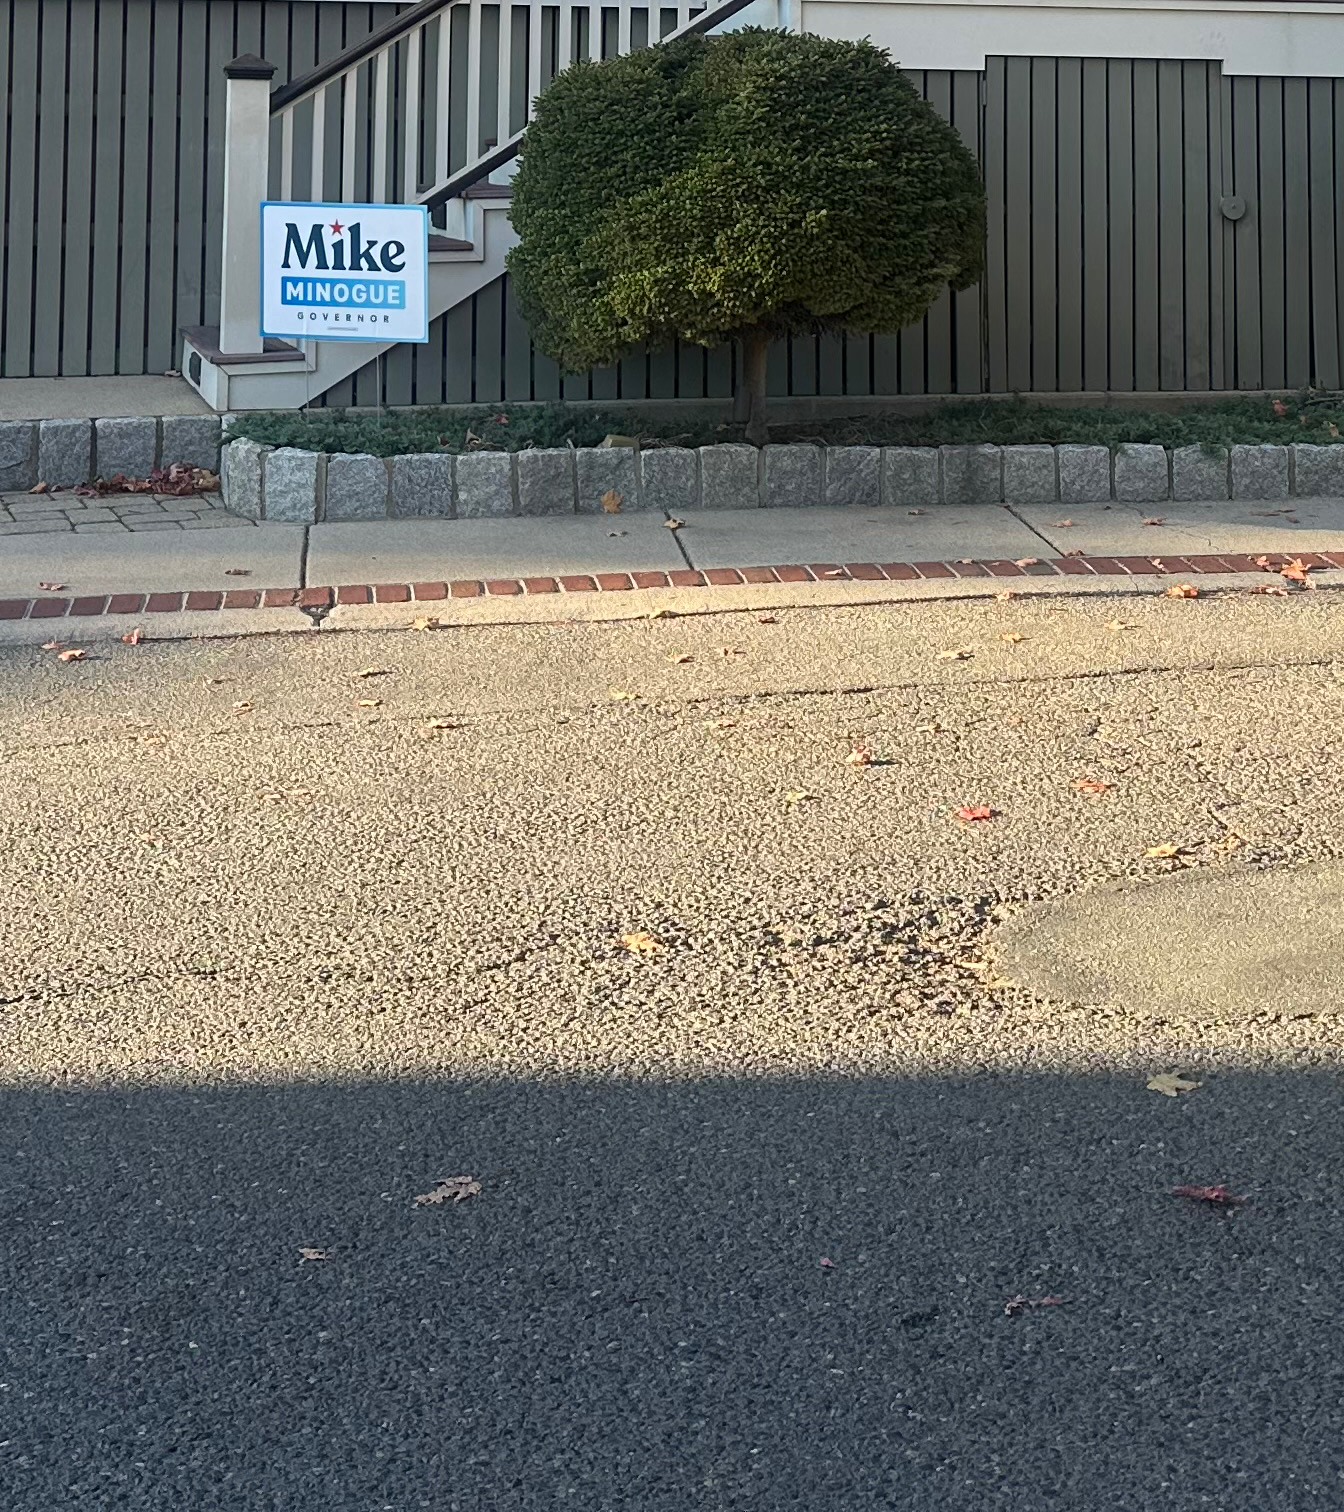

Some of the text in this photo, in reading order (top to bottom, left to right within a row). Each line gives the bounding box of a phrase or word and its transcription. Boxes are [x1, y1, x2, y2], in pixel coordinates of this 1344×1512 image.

[281, 220, 406, 273] Mike
[286, 280, 400, 305] MINOGUE
[297, 311, 390, 324] GOVERNOR
